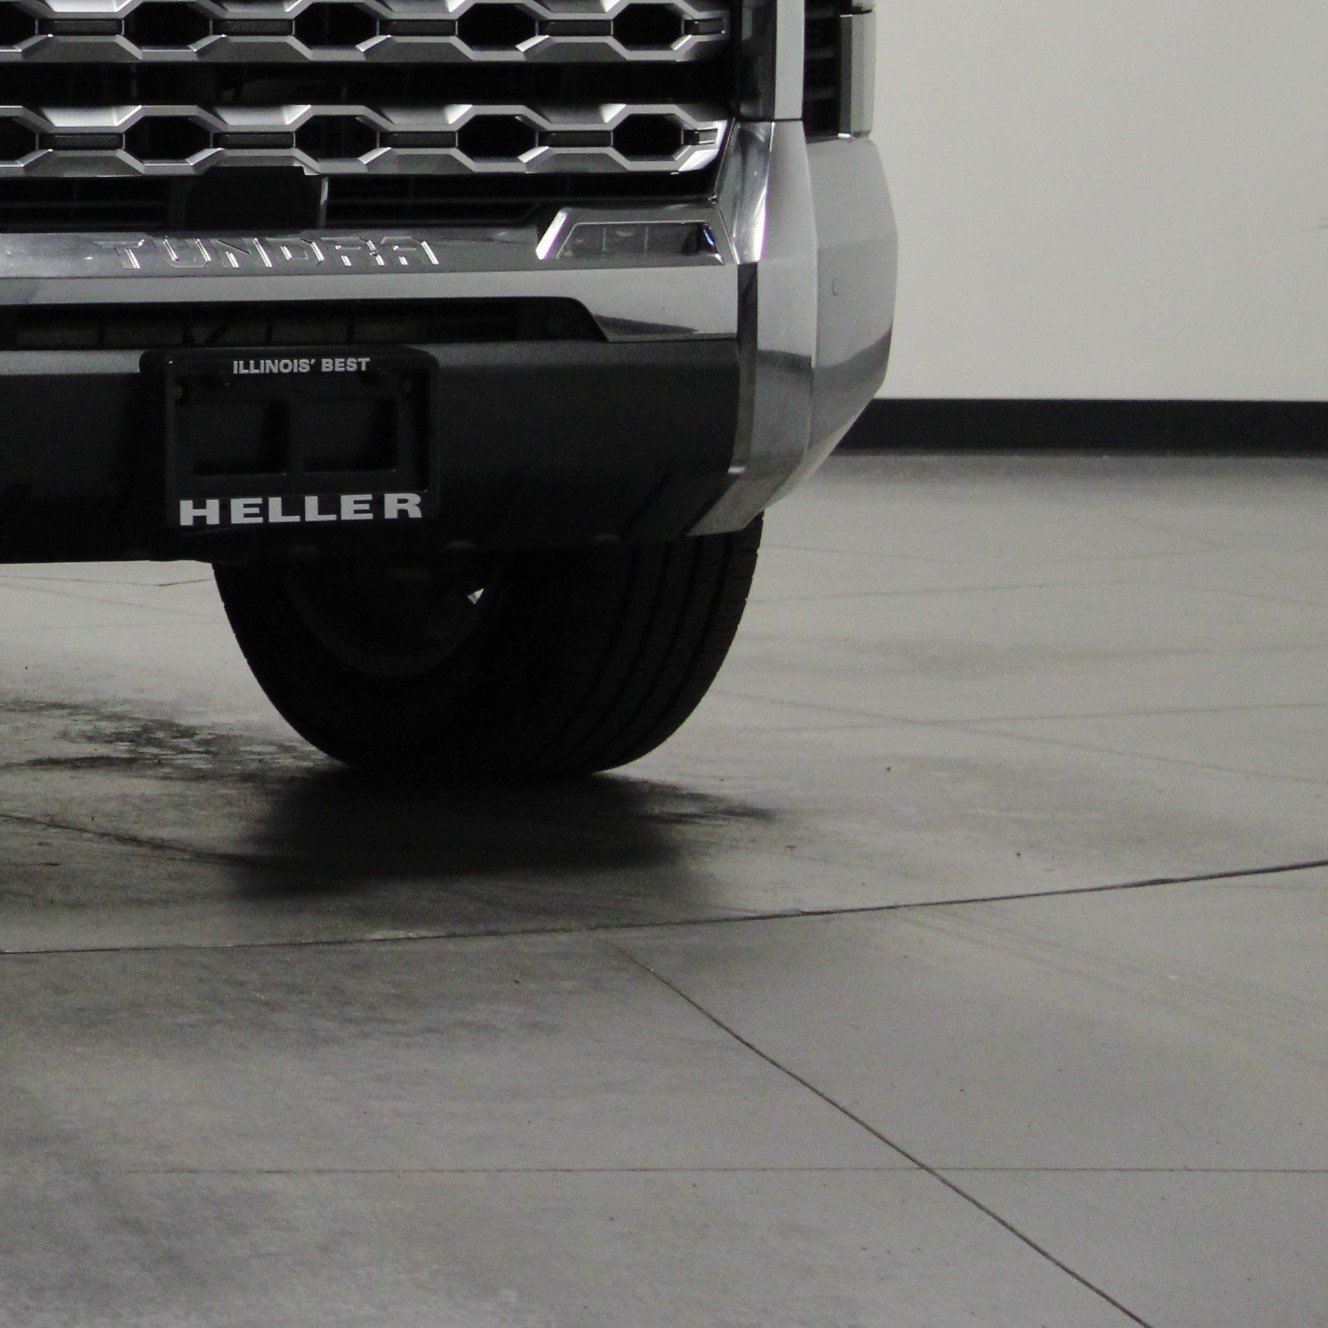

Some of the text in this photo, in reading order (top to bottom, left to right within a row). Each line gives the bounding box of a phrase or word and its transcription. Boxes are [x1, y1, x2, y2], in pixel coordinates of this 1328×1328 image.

[94, 236, 440, 269] TUNDRA
[232, 357, 371, 374] ILLINOIS' BEST
[179, 492, 423, 526] HELLER
